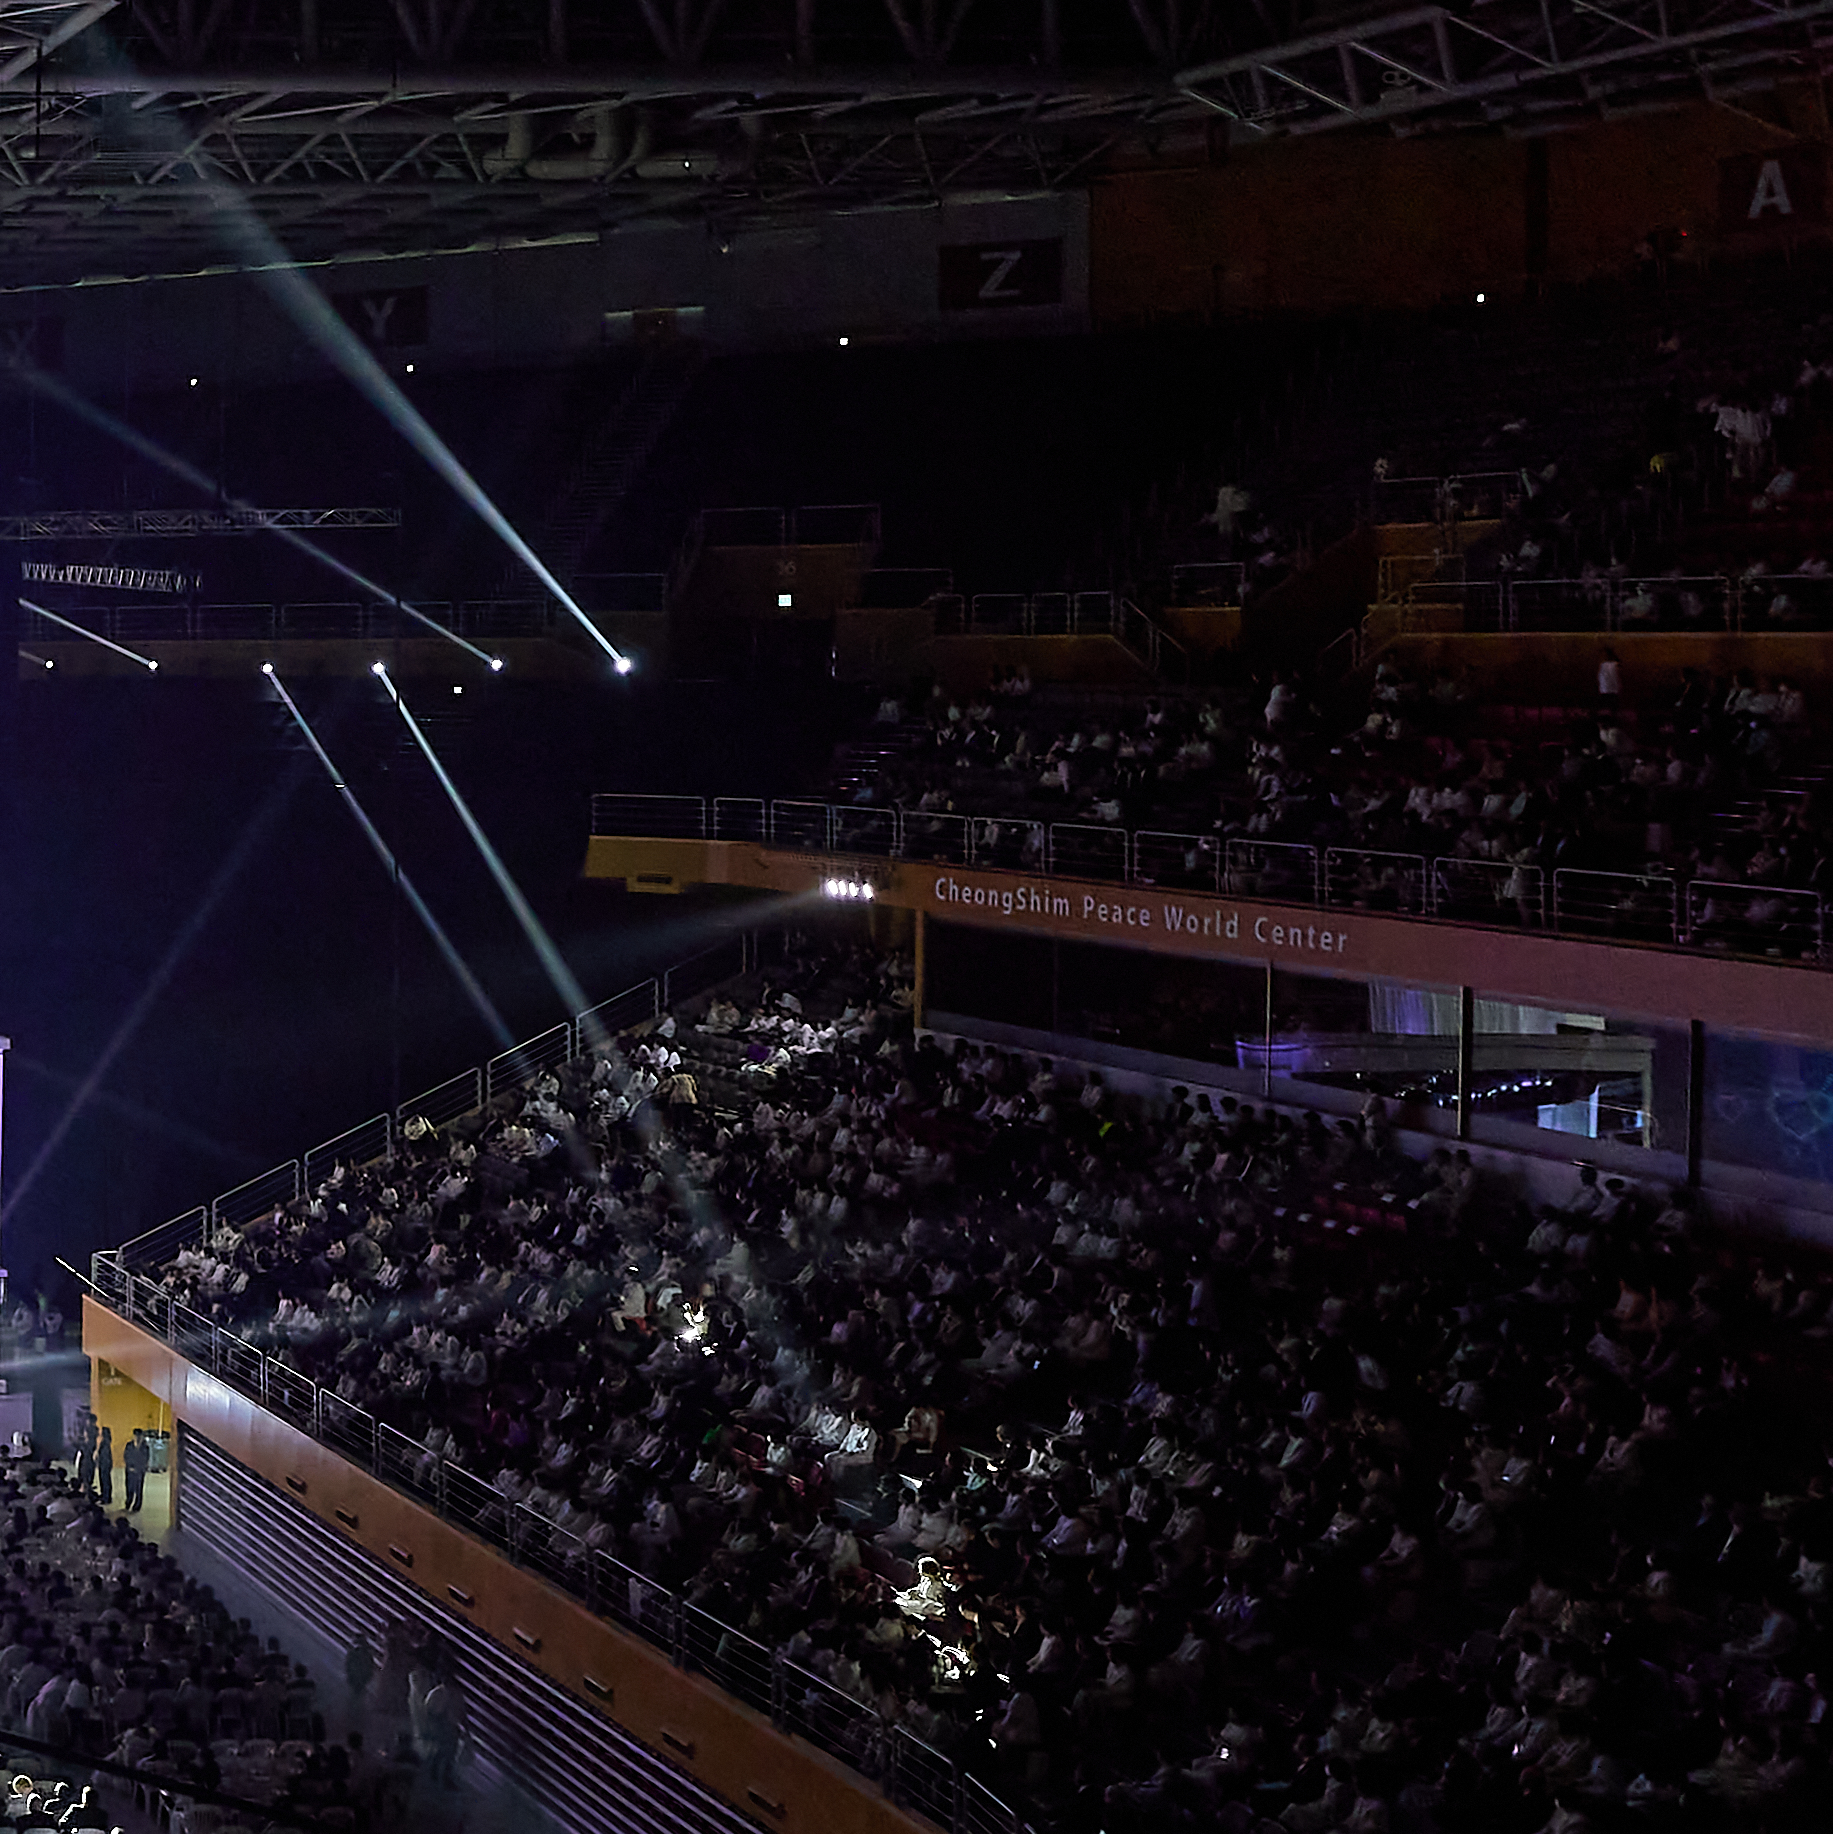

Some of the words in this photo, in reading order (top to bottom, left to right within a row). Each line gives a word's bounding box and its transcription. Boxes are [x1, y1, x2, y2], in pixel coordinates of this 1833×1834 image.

[1747, 159, 1795, 219] A
[978, 250, 1022, 298] Z
[362, 296, 397, 339] Y
[935, 877, 1070, 917] CheongShim
[1083, 895, 1151, 927] Peace
[1164, 905, 1239, 939] World
[1254, 916, 1348, 952] Center
